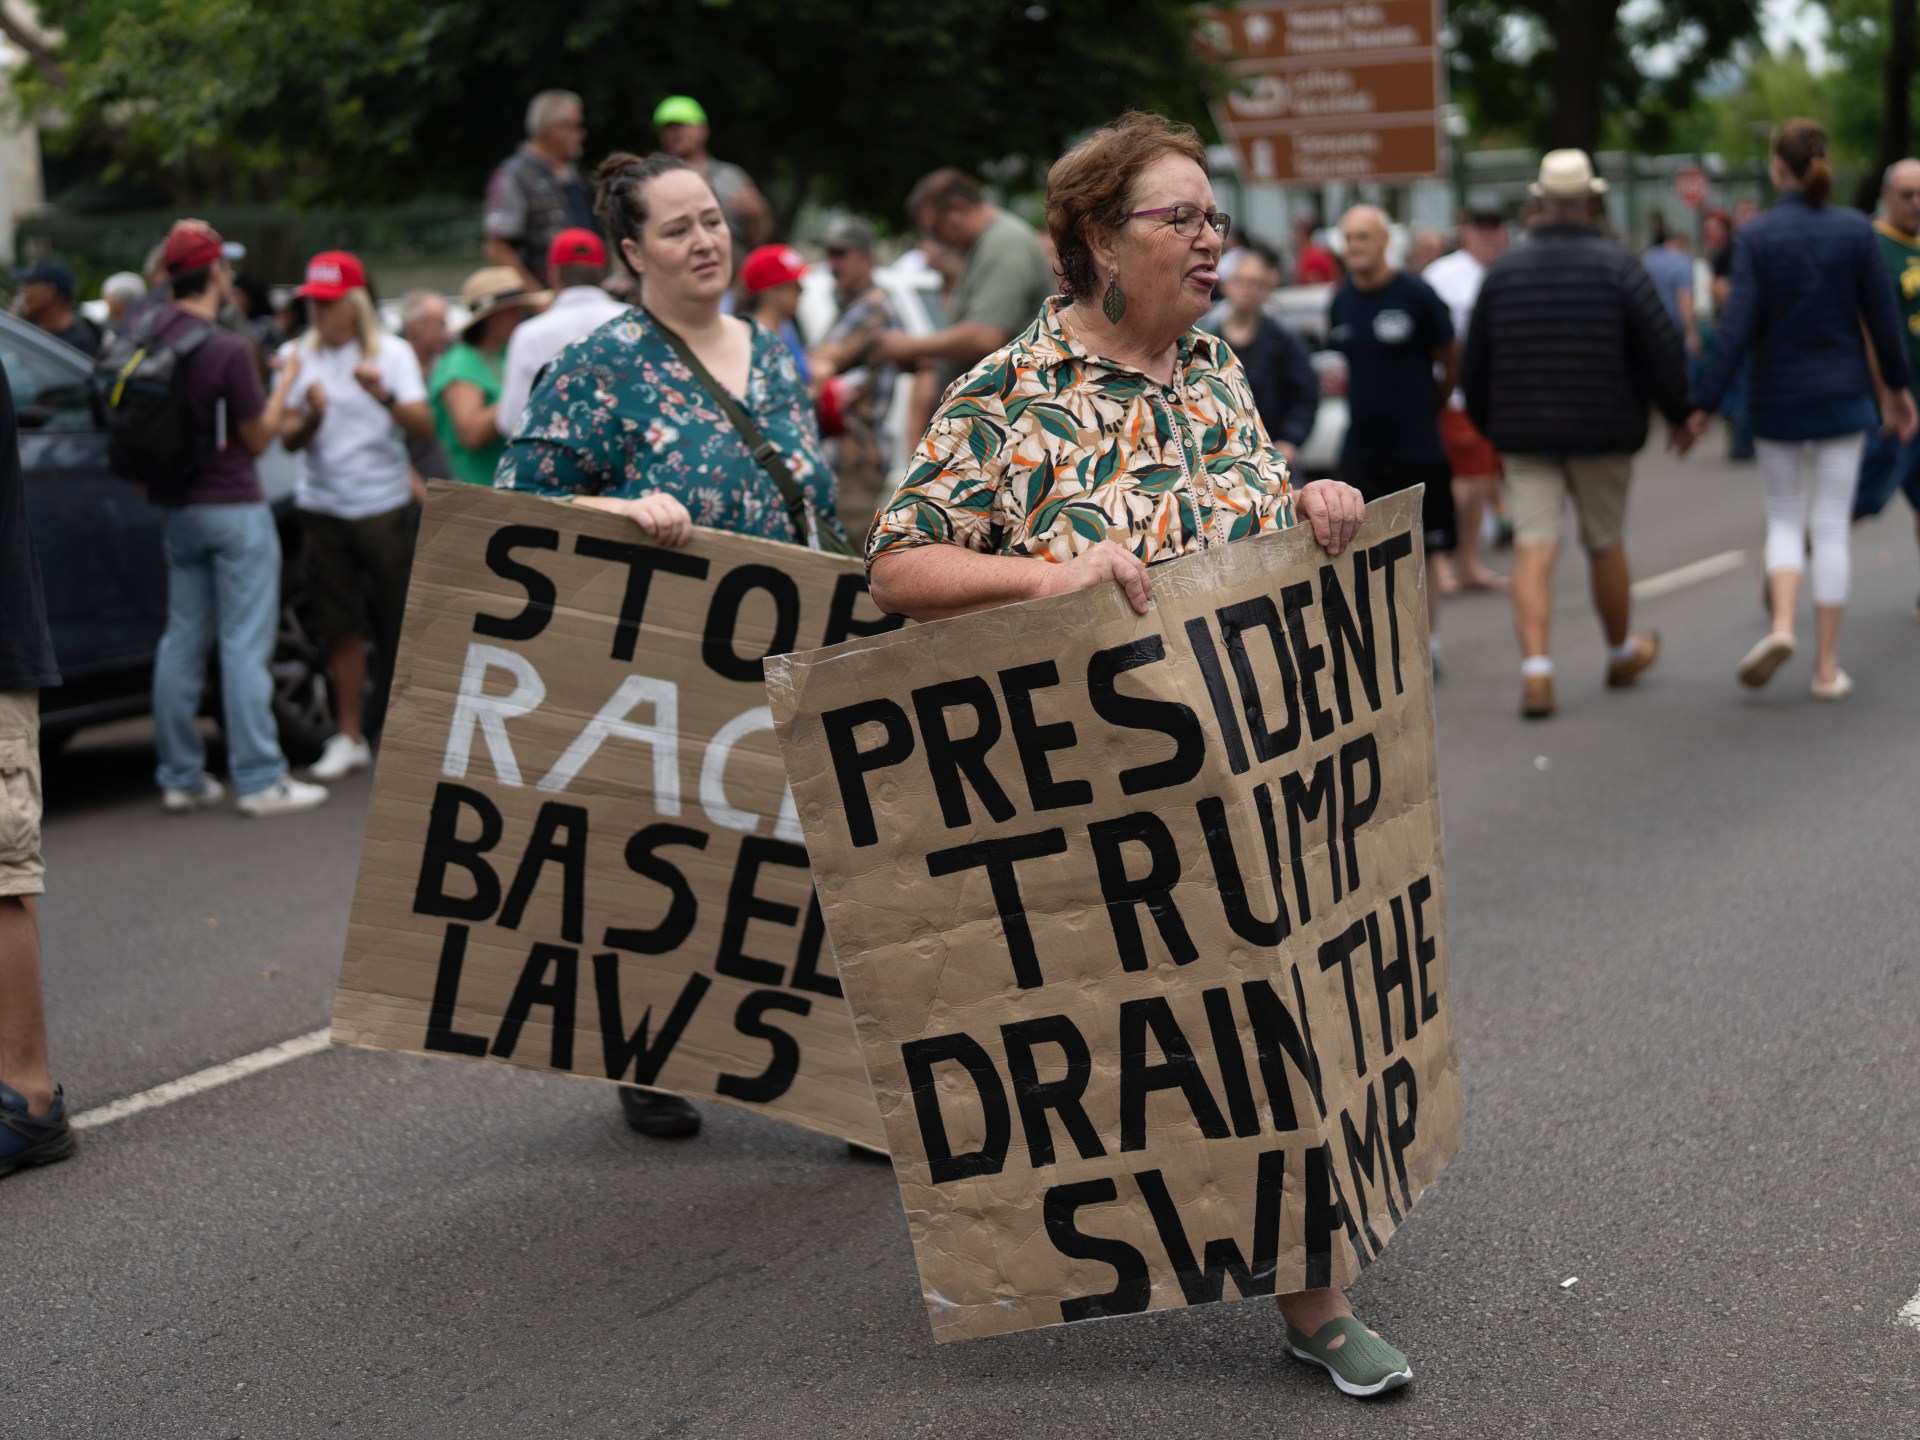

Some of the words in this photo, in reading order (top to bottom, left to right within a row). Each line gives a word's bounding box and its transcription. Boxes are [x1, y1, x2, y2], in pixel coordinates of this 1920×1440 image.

[821, 531, 1412, 848] PRESIDENT
[926, 733, 1382, 989] TRUMP
[424, 922, 812, 1104] LAWS
[901, 963, 1327, 1184] DRAIN
[1318, 874, 1438, 1078] THE
[1043, 1056, 1418, 1323] SWAMP
